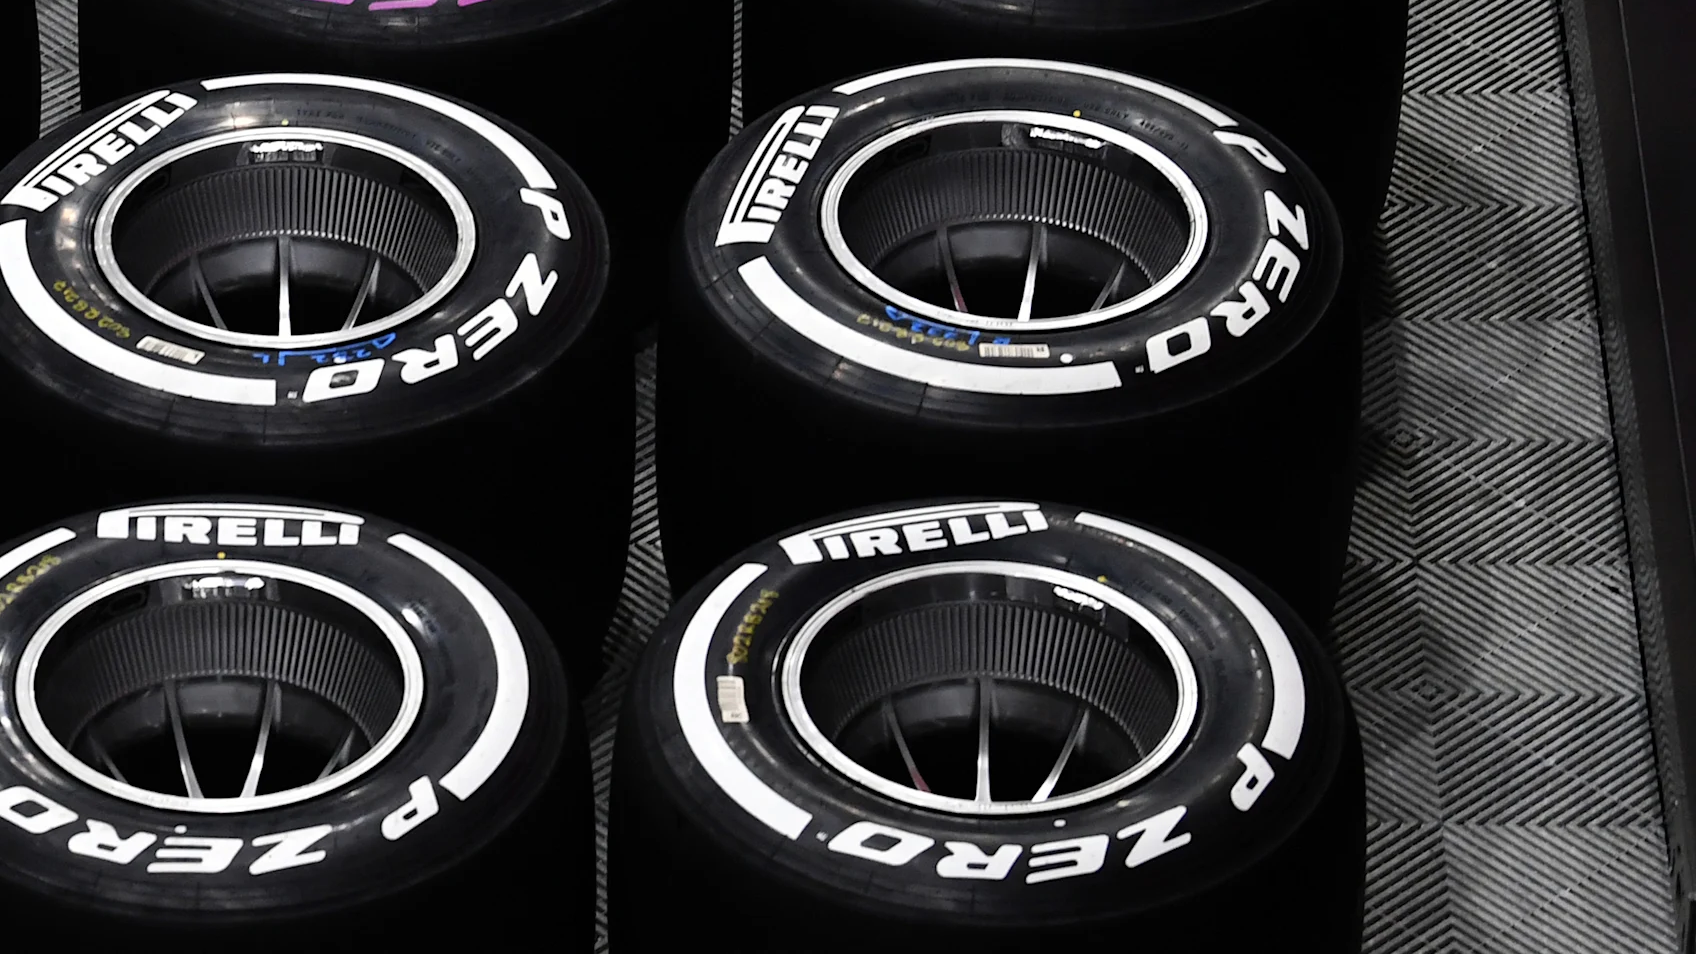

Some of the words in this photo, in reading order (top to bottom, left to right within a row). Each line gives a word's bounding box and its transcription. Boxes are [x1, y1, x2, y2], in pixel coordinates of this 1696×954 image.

[0, 89, 199, 213] PIRELLI
[715, 104, 840, 248] PIRELLI
[1213, 130, 1288, 174] P
[520, 187, 572, 241] P
[1146, 189, 1310, 374] ZERO
[302, 252, 560, 404] ZERO
[96, 502, 366, 547] PIRELLI
[777, 501, 1050, 566] PIRELLI
[380, 774, 440, 842] P
[1229, 741, 1276, 812] P
[826, 805, 1192, 886] ZERO
